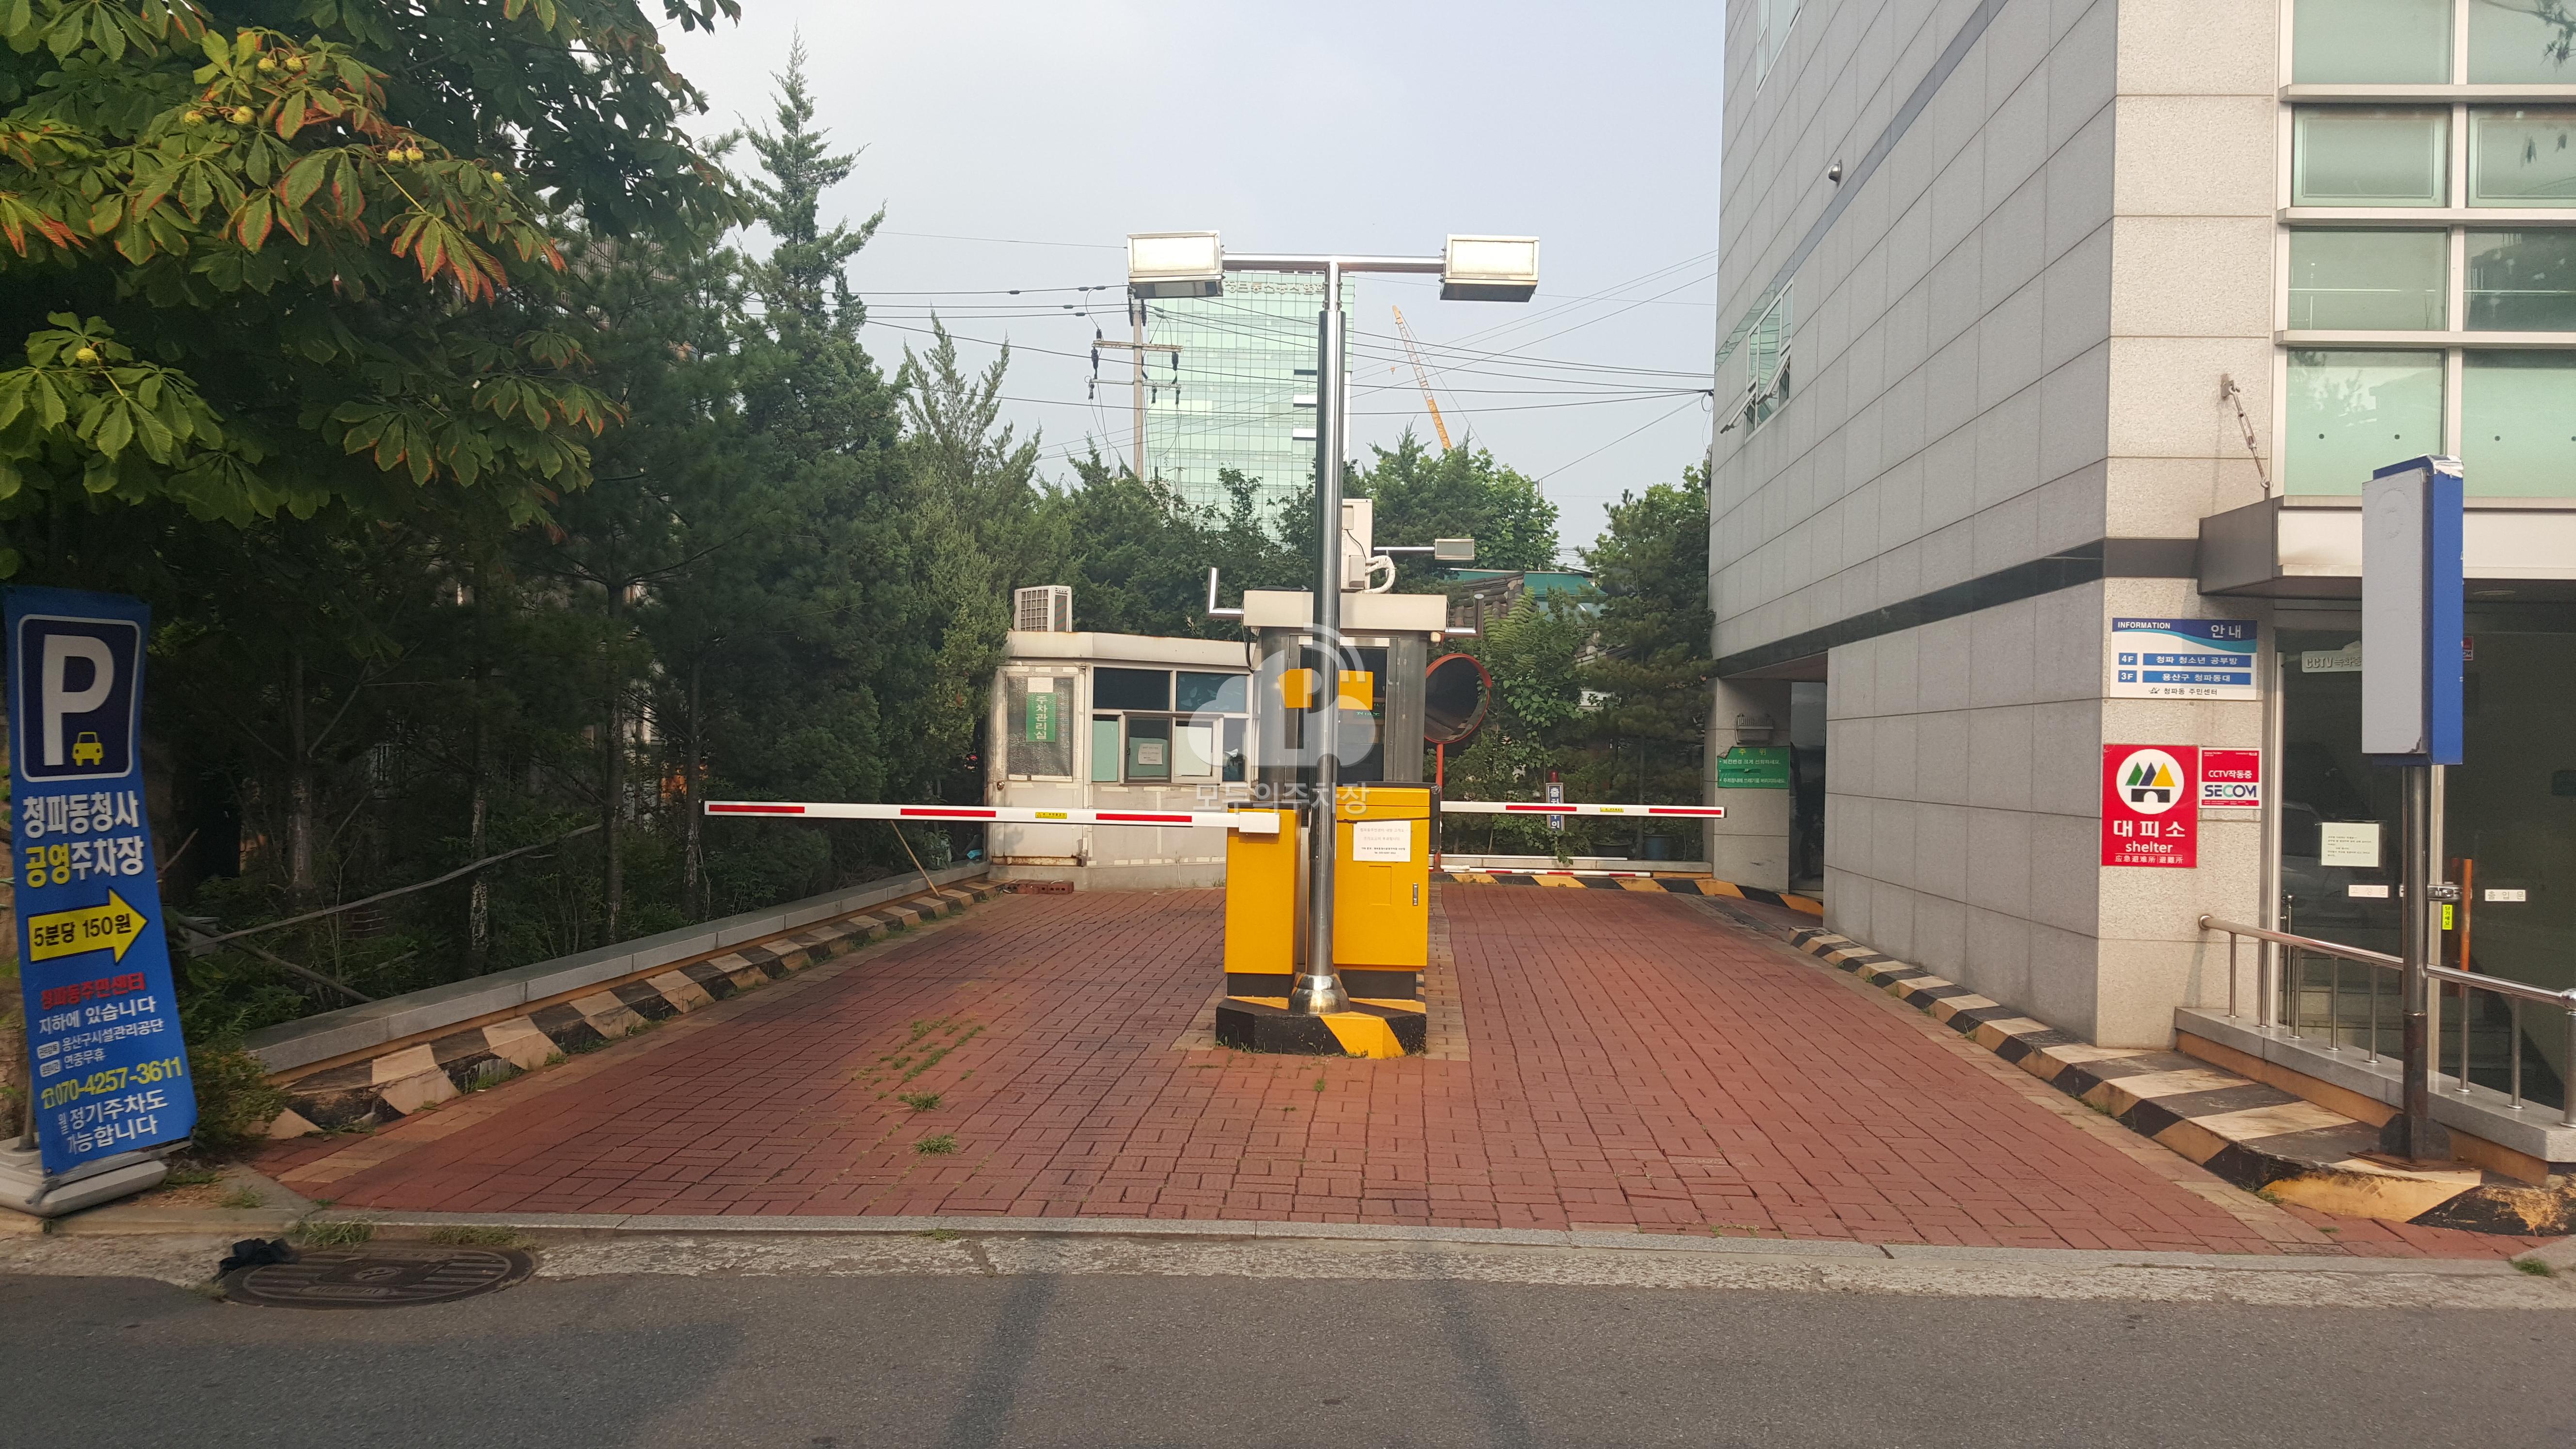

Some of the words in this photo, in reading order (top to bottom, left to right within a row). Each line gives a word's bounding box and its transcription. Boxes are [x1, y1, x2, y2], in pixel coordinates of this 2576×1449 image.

[2179, 656, 2206, 664] 청소년
[2210, 657, 2238, 665] 공부방
[2305, 657, 2333, 668] CCTV
[2334, 656, 2362, 667] 녹화중
[2162, 673, 2190, 681] 용산구
[2194, 674, 2231, 682] 청파동대
[42, 634, 114, 766] P
[2189, 688, 2218, 696] 주민센터
[1035, 695, 1048, 740] 주차관리실
[2208, 770, 2253, 779] CCTV작동중
[2205, 784, 2257, 798] SECOM
[23, 790, 140, 838] 청파동청사
[2113, 820, 2186, 838] 대피소
[2125, 840, 2173, 853] shelter
[25, 836, 145, 888] 공영주차장
[2488, 891, 2524, 900] 출입문
[34, 921, 76, 947] 5분당
[82, 913, 131, 938] 150원
[41, 971, 146, 1010] 청파동주민센터
[39, 1010, 81, 1035] 지하에
[85, 996, 157, 1025] 있습니다
[62, 1018, 165, 1052] 용산구시설관리공단
[64, 1047, 107, 1069] 연중무휴
[69, 1089, 169, 1130] 정기주차도
[67, 1114, 159, 1155] 가능합니다
